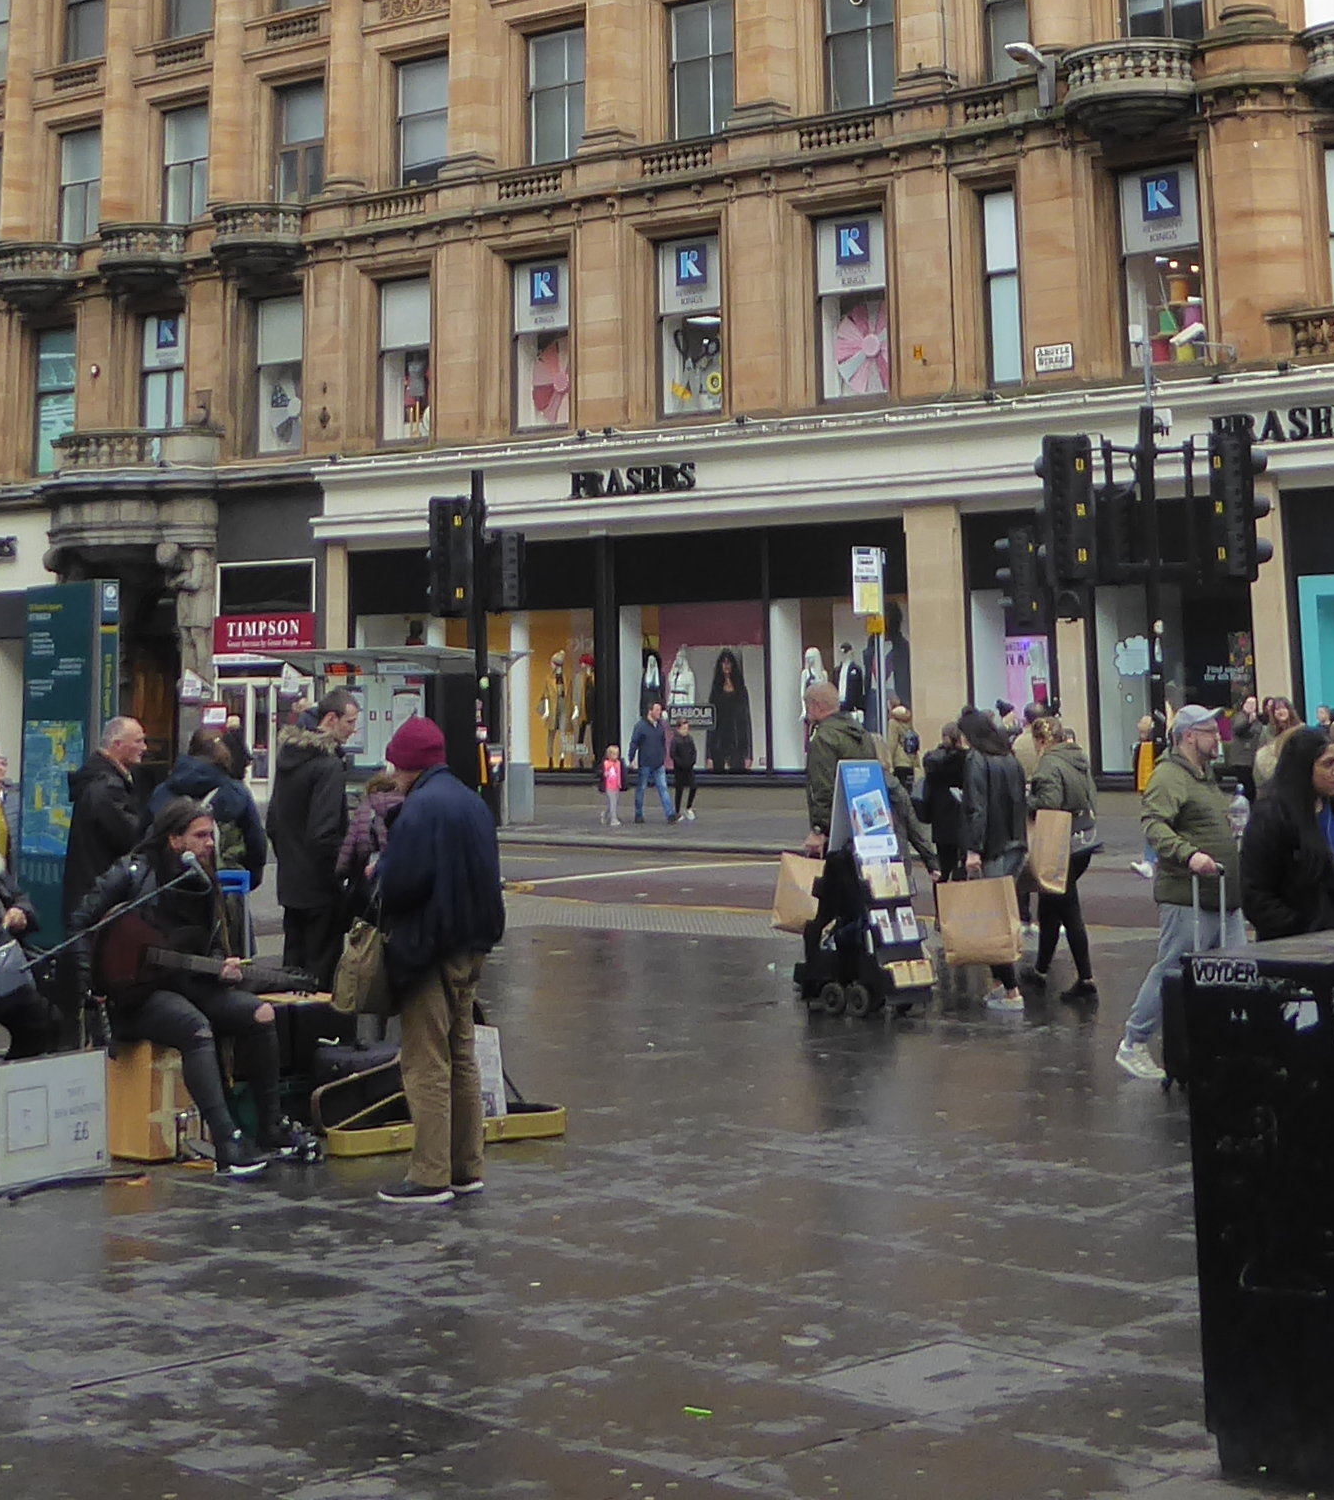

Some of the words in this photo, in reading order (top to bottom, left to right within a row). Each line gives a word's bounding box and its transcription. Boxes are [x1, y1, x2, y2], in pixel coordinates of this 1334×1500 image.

[1038, 355, 1069, 365] STREET
[570, 462, 697, 498] FRASERS
[227, 619, 300, 637] TIMPSON
[671, 707, 712, 719] BARBOUR
